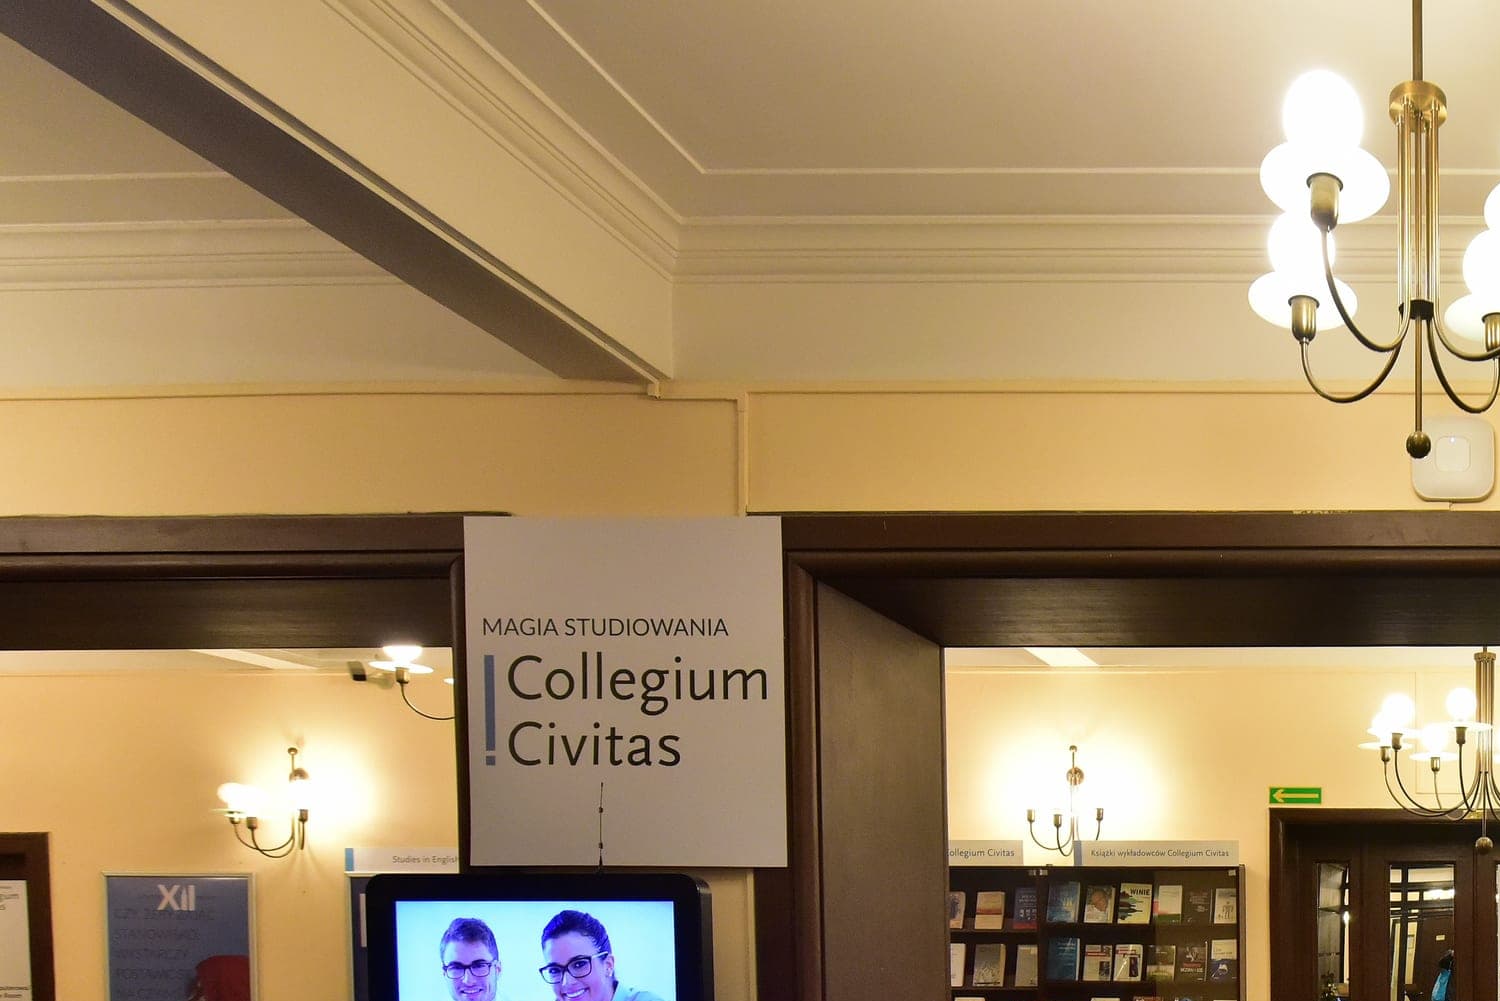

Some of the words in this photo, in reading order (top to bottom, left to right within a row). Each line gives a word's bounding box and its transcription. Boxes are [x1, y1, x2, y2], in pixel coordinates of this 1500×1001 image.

[483, 617, 559, 637] MAGIA
[564, 617, 729, 637] STUDIOWANIA
[507, 651, 768, 716] Collegium
[507, 720, 682, 767] Civitas
[987, 848, 1015, 858] Civitas
[1167, 849, 1204, 859] Collegium
[1205, 849, 1230, 858] Civitas
